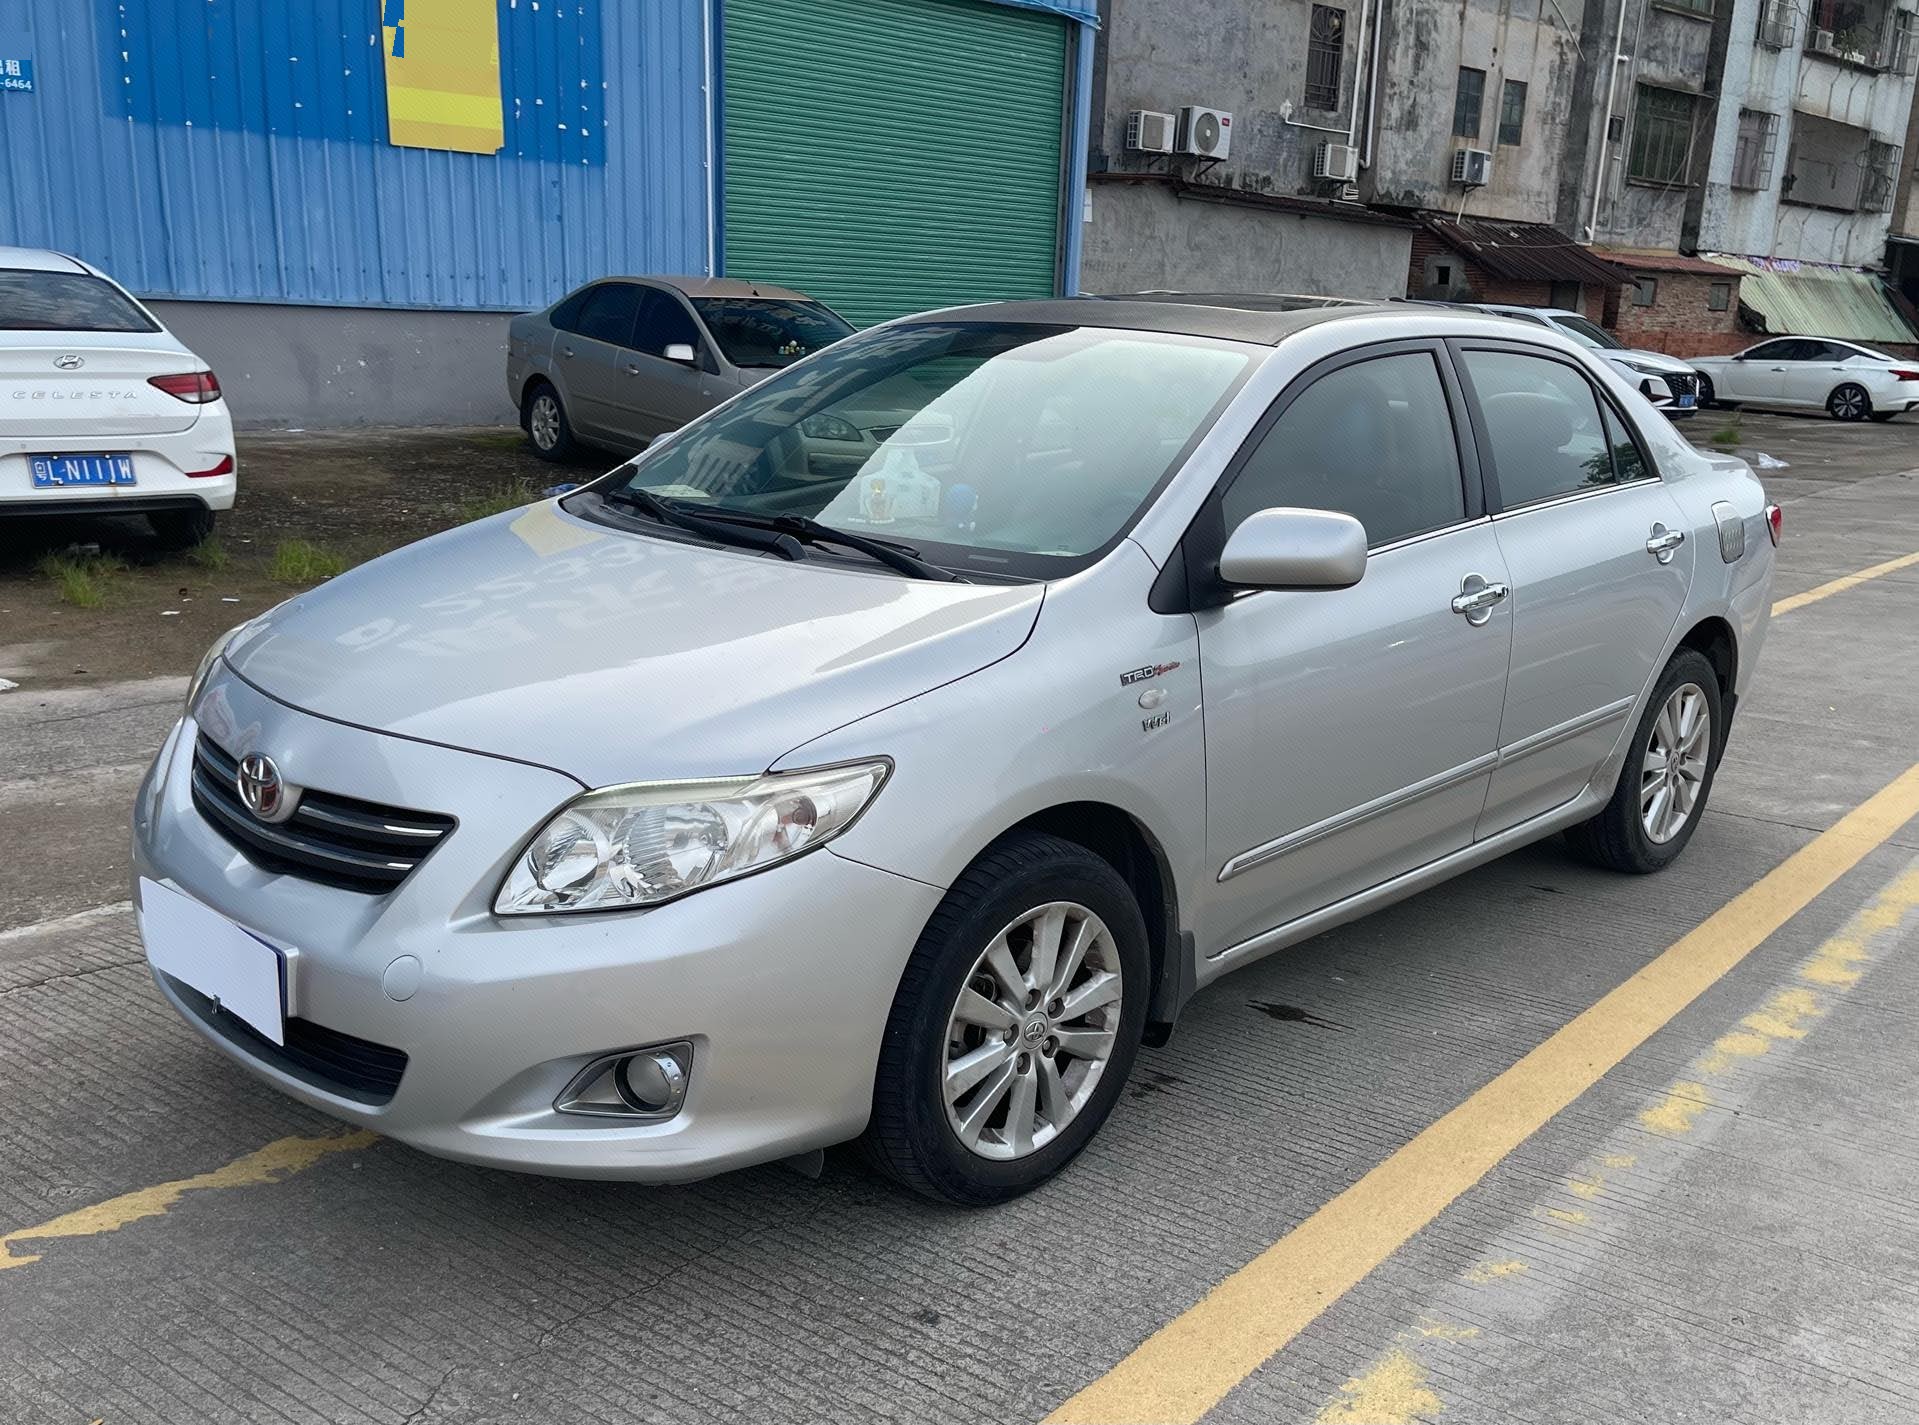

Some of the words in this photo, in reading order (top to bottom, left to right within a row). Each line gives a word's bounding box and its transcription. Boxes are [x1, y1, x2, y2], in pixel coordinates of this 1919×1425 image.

[0, 60, 21, 76] 租
[12, 390, 138, 400] CELESTA
[1121, 666, 1155, 685] TRD
